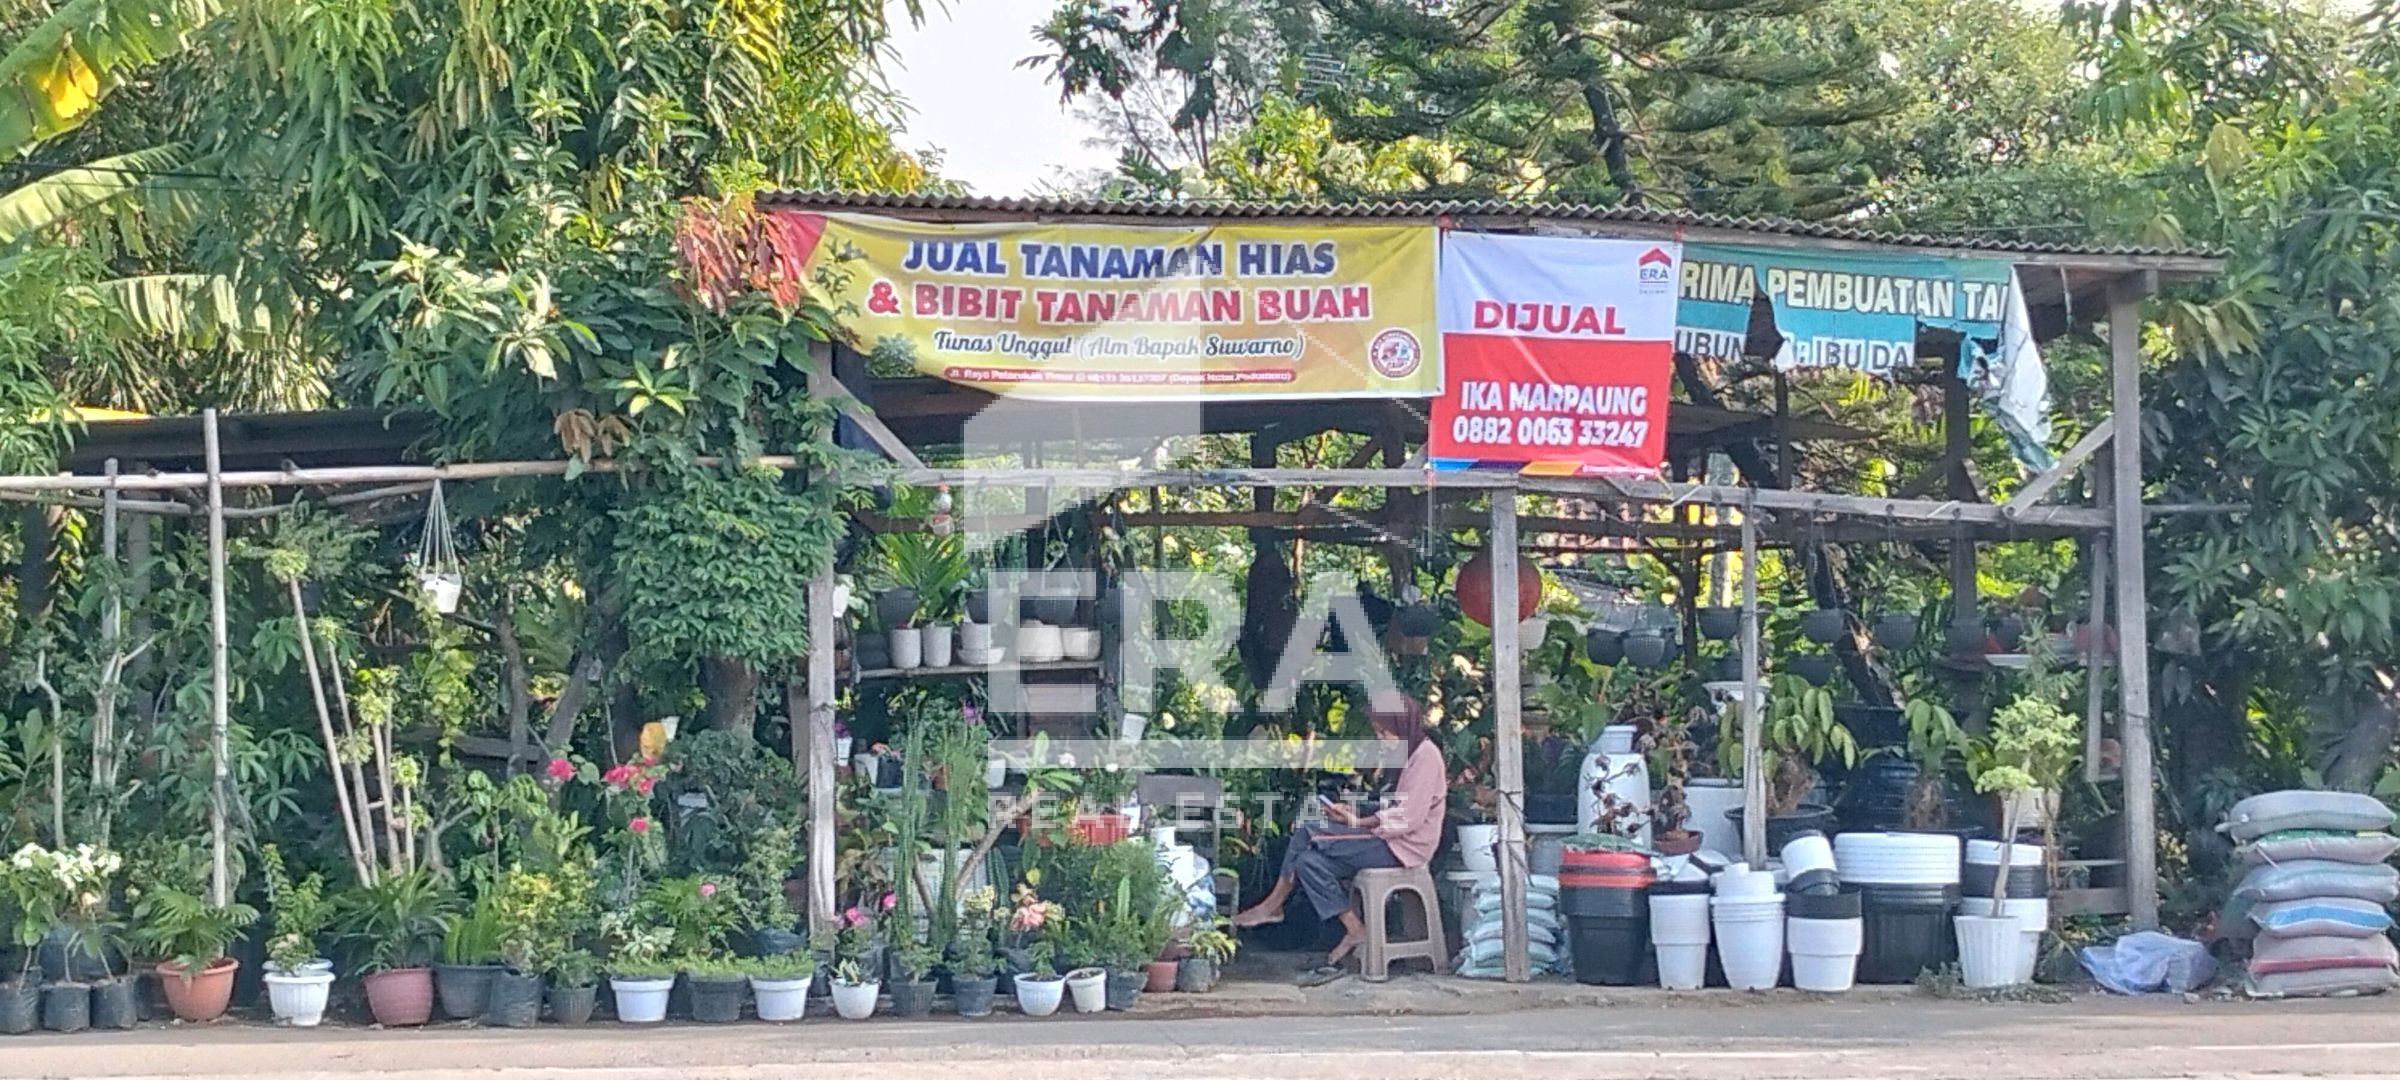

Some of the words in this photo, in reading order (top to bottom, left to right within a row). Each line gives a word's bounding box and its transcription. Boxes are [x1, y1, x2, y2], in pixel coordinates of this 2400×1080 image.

[904, 240, 1006, 274] JUAL
[1021, 243, 1222, 279] TANAMAN
[1240, 242, 1335, 275] HIAS
[1640, 267, 1669, 280] ERA
[868, 281, 901, 315] &
[914, 283, 1023, 319] BIBIT
[1035, 289, 1241, 322] TANAMAN
[1258, 286, 1370, 320] BUAH
[1766, 268, 1954, 318] PEMBUATAN
[1474, 300, 1625, 335] DIJUAL
[934, 331, 993, 352] Tunas
[1134, 336, 1199, 360] Bapak
[1816, 340, 1862, 369] IBU
[1461, 381, 1504, 411] IKA
[1508, 382, 1648, 416] MARPAUNG
[1453, 415, 1512, 445] 0882
[1517, 416, 1574, 446] 0063
[1577, 419, 1648, 449] 33247
